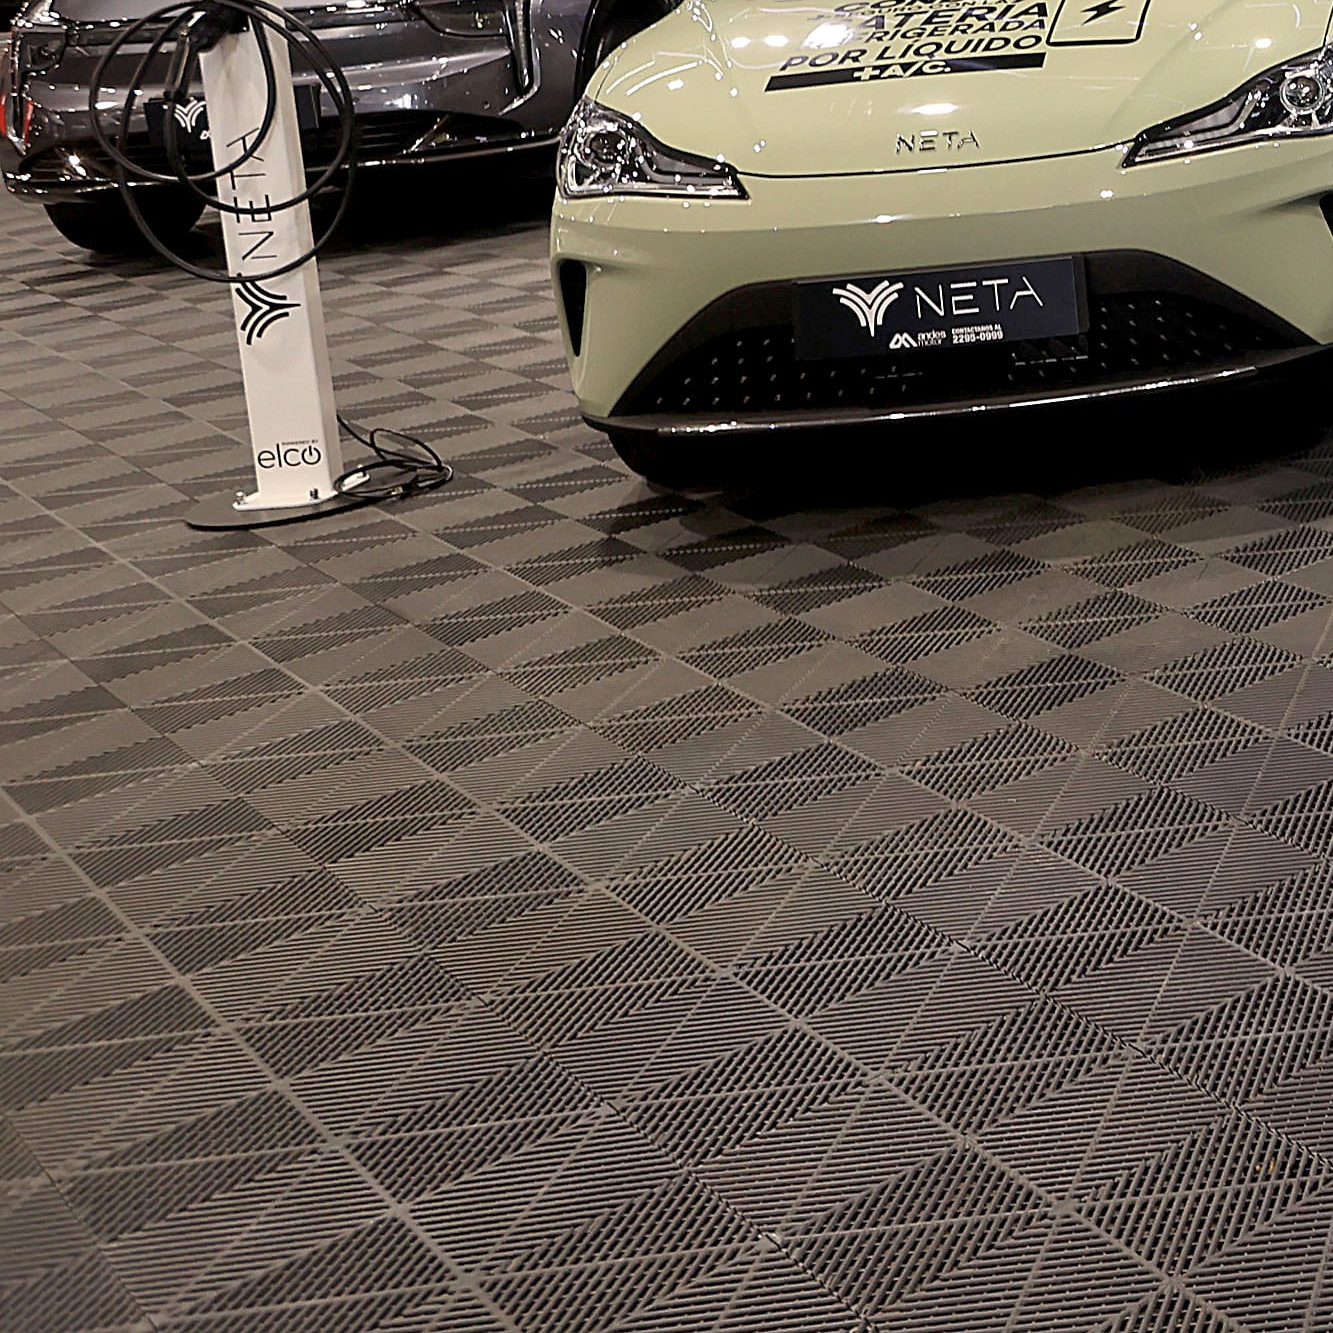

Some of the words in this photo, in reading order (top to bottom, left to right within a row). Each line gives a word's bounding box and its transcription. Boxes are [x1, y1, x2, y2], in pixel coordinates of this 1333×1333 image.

[779, 49, 867, 71] POR
[875, 34, 1042, 61] LÍQUIDO
[895, 129, 981, 154] NETA
[225, 126, 278, 262] NETA
[914, 276, 1044, 319] NETA
